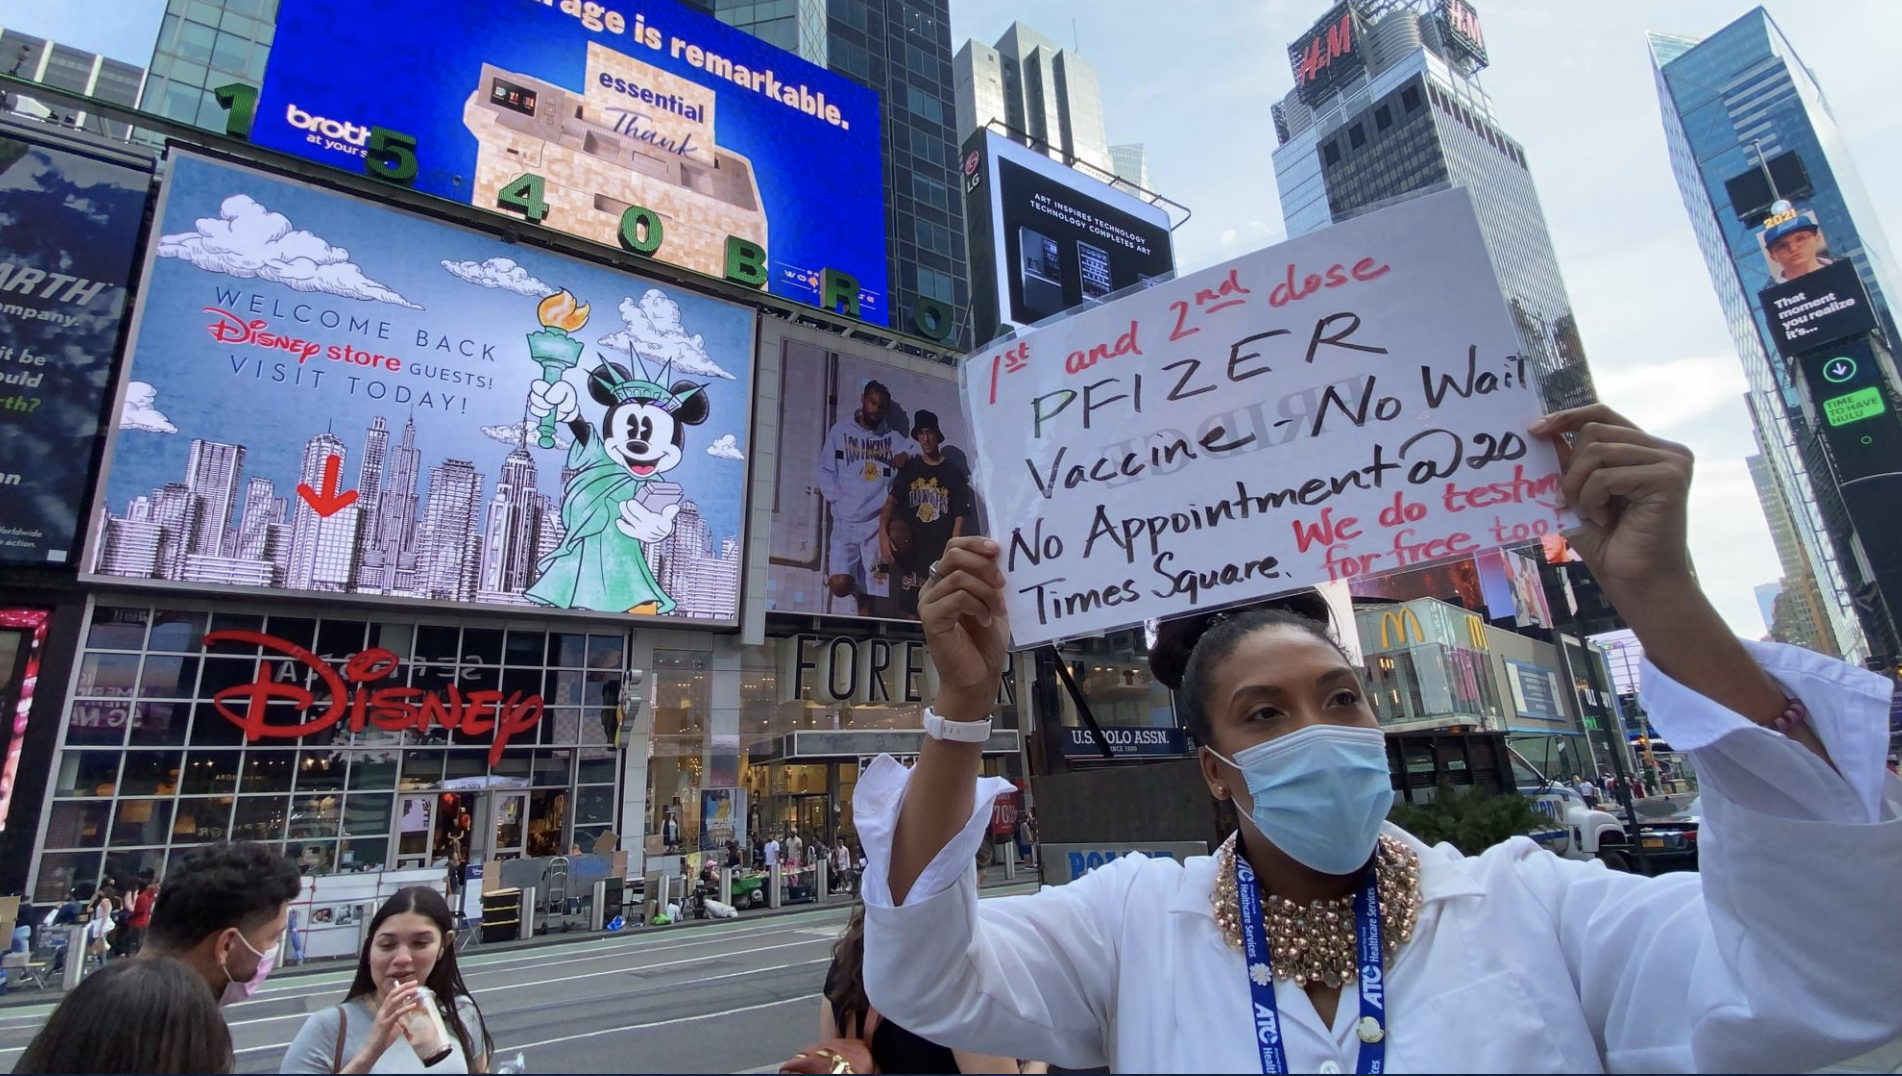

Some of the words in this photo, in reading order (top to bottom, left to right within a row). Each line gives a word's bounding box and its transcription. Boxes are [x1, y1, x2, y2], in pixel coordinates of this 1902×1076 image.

[635, 14, 662, 50] is
[671, 36, 849, 131] remarkable.
[599, 72, 704, 124] essential
[306, 132, 322, 145] at
[325, 138, 359, 155] your
[605, 107, 698, 156] Thank
[967, 174, 980, 193] LG
[1030, 200, 1087, 229] TECHNOLOGY
[1089, 225, 1134, 250] COMPLETES
[1136, 243, 1151, 256] ART
[1034, 192, 1052, 205] ART
[1054, 201, 1092, 223] INSPIRES
[1094, 218, 1146, 245] TECHNOLOGY
[1763, 207, 1798, 230] 2021
[215, 286, 391, 341] WELCOME
[415, 329, 497, 363] BACK
[1065, 320, 1143, 376] and
[1268, 255, 1391, 309] dose
[1774, 292, 1807, 310] That
[1778, 292, 1837, 320] moment
[1782, 313, 1808, 331] you
[1809, 296, 1856, 321] realize
[18, 348, 46, 367] be
[202, 307, 321, 365] Disney
[326, 345, 401, 372] store
[409, 362, 494, 391] GUESTS!
[230, 354, 326, 390] VISIT
[347, 375, 468, 415] TODAY!
[1031, 312, 1388, 439] PFIZER
[1025, 425, 1257, 500] Vaccine
[1310, 374, 1402, 438] No
[1420, 344, 1529, 409] Wait
[1826, 396, 1854, 410] TIME
[1829, 406, 1845, 417] TO
[1847, 396, 1879, 413] HAVE
[1832, 409, 1864, 426] HULU
[1008, 517, 1064, 573] No
[1083, 443, 1402, 565] Appointment
[1292, 507, 1363, 554] We
[1379, 491, 1428, 528] do
[1319, 543, 1381, 588] for
[1387, 529, 1481, 579] free
[1018, 577, 1140, 625] Times
[794, 632, 1015, 705] FORER
[202, 629, 544, 768] Disney
[1071, 729, 1096, 745] U.S.
[1134, 729, 1170, 745] ASSN.
[1368, 918, 1380, 963] Healthcare
[1362, 965, 1383, 1010] ATC
[1255, 1002, 1278, 1045] ATC
